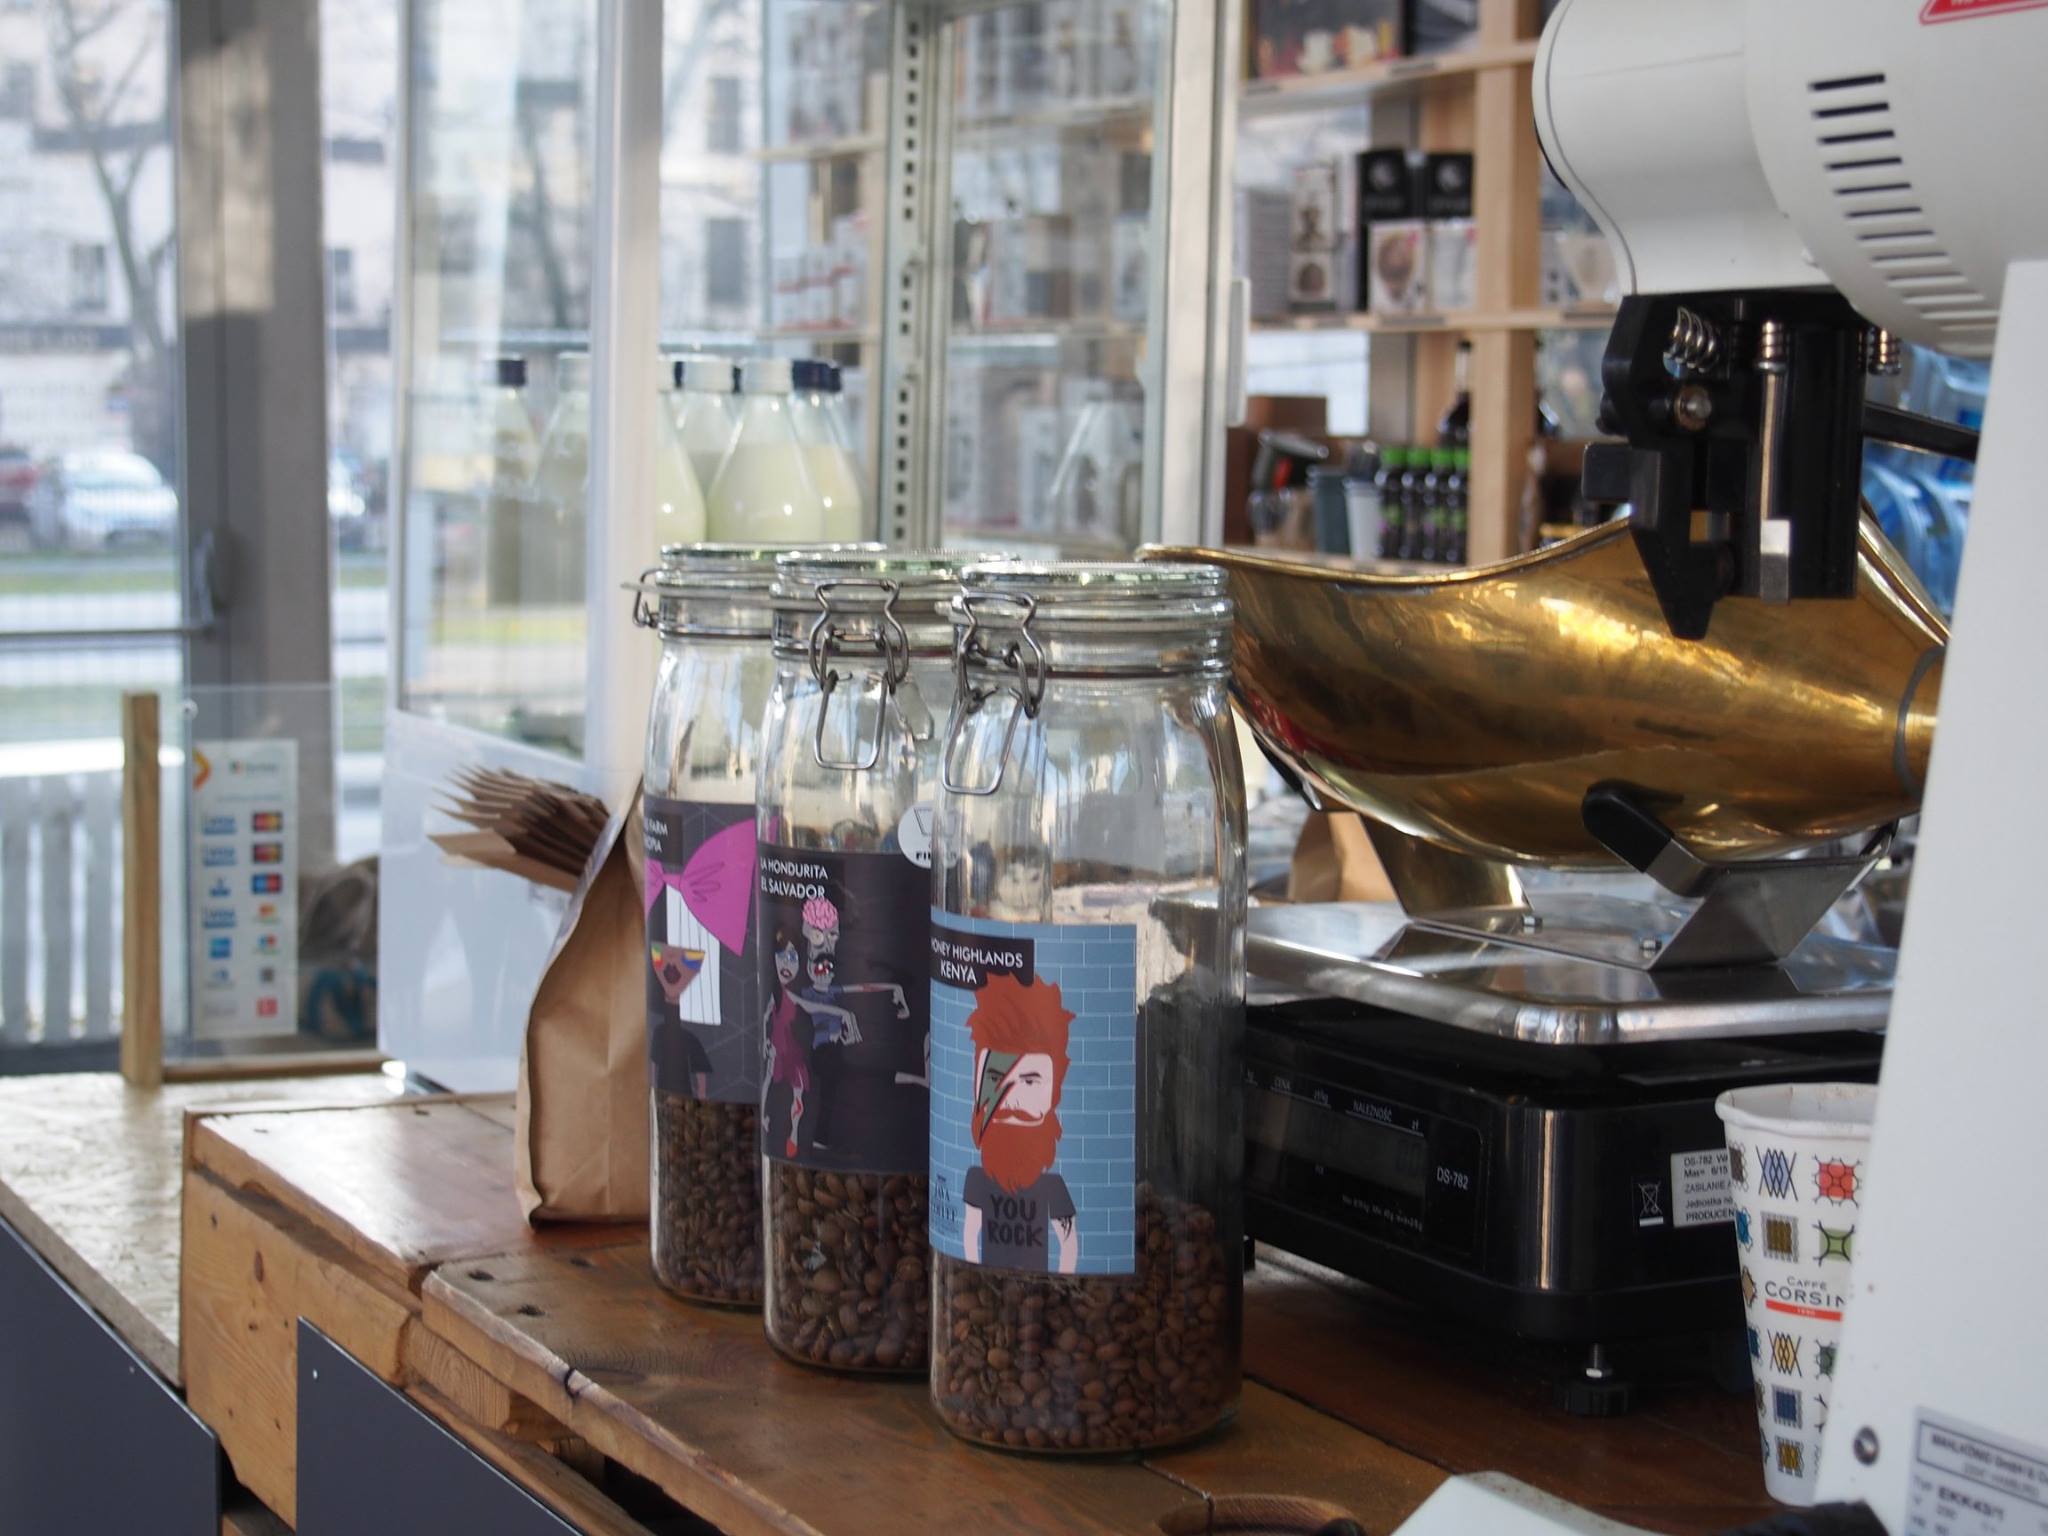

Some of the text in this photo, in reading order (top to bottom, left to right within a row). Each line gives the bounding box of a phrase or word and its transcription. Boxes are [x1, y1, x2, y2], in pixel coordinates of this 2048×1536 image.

[760, 856, 829, 880] LA HONDURITA
[760, 875, 826, 900] EL SALVADOR
[952, 944, 1024, 969] HIGHLANDS
[940, 960, 977, 984] KENYA
[1436, 1165, 1469, 1191] DS-782
[990, 1193, 1037, 1222] YOU
[987, 1220, 1043, 1249] ROCK
